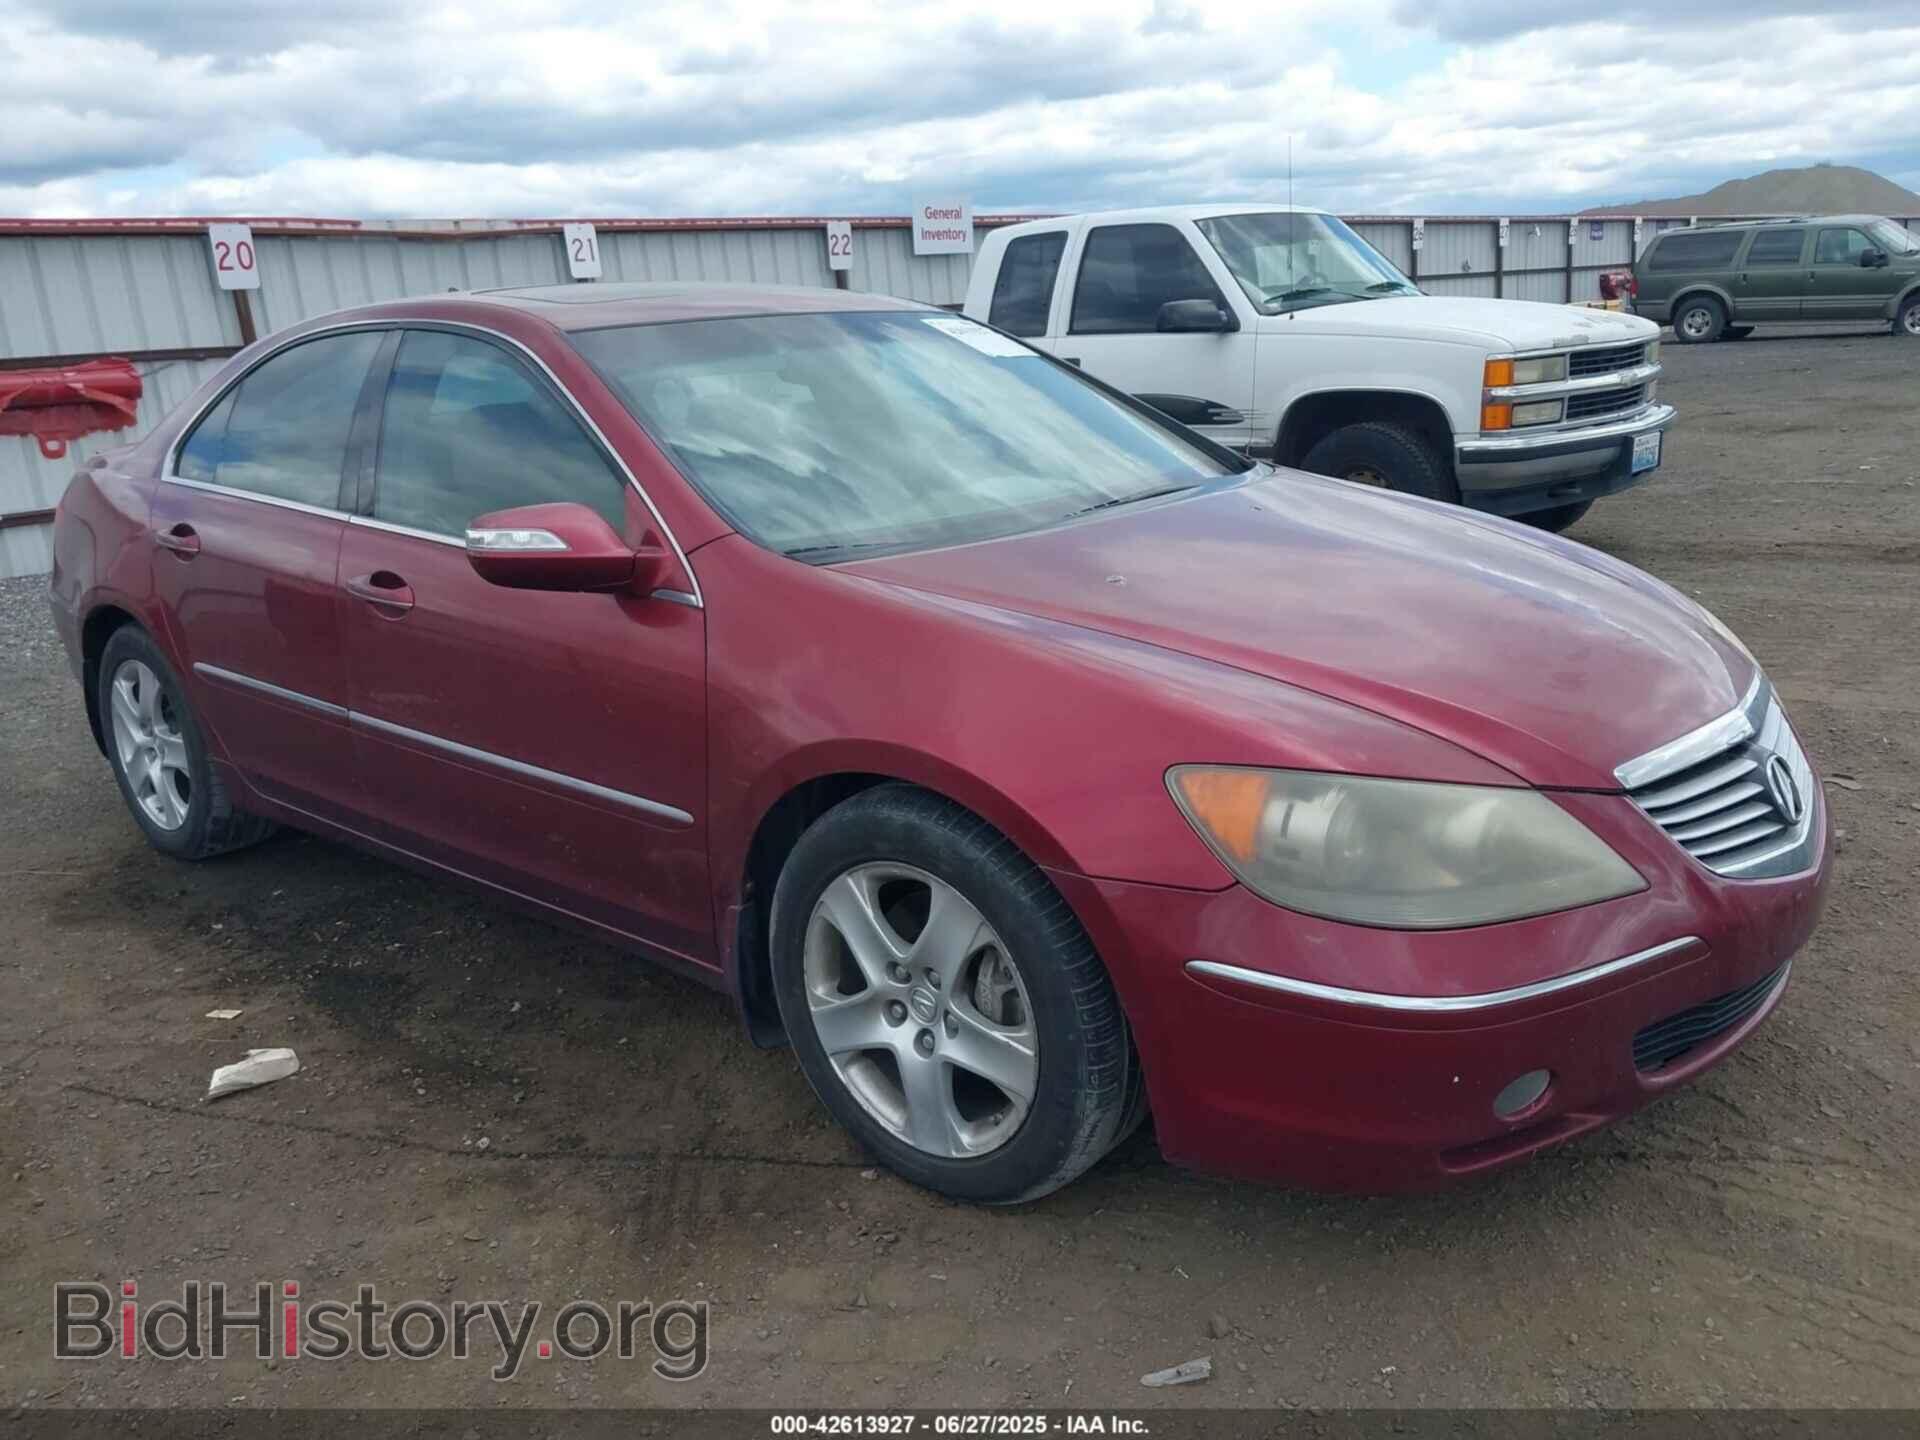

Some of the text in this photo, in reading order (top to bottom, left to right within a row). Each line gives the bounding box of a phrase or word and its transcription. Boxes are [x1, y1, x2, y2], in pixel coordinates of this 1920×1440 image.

[924, 206, 963, 220] General
[830, 234, 851, 256] 22
[920, 227, 967, 242] Inventory
[215, 241, 254, 271] 20
[571, 238, 595, 262] 21
